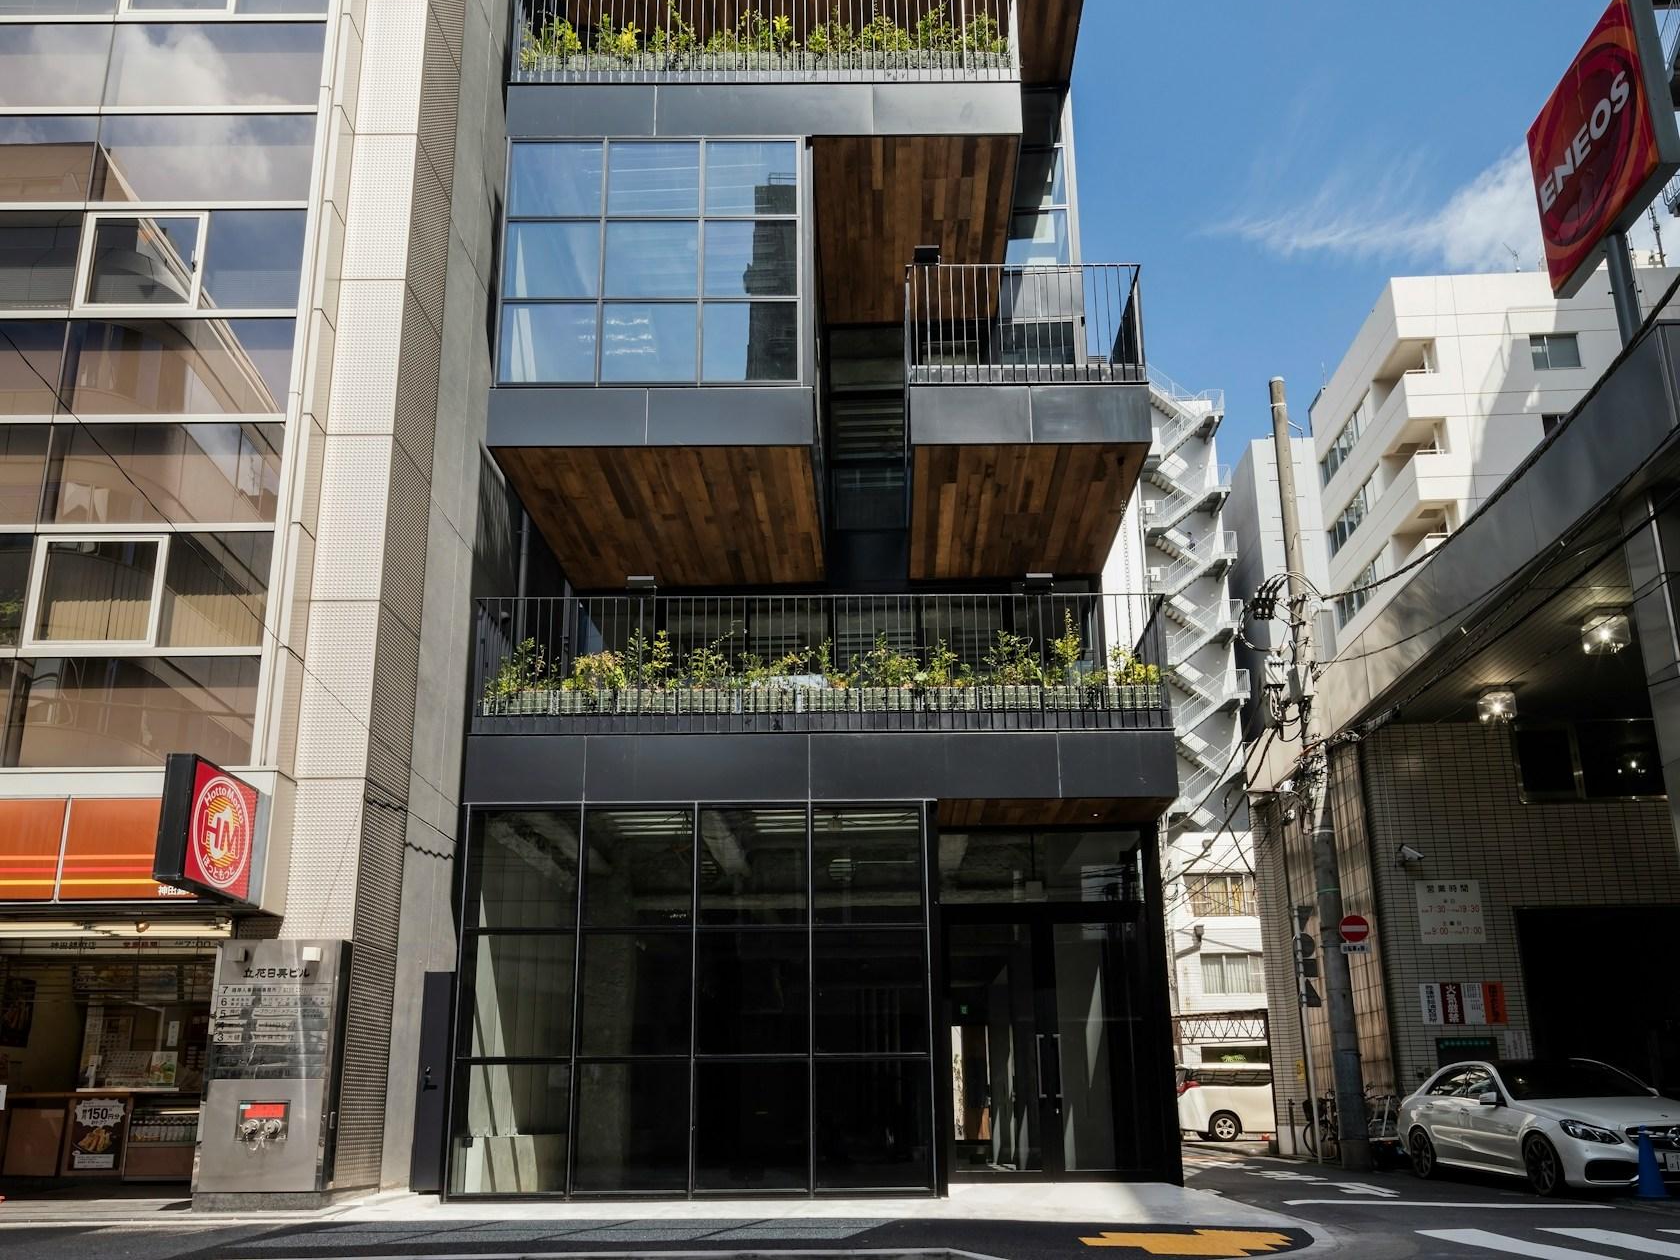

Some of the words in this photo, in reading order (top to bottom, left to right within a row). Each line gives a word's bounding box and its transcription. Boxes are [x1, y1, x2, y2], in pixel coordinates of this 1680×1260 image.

[1539, 70, 1631, 215] ENEOS
[204, 786, 227, 807] Hotto
[203, 854, 236, 880] ほっともっと
[222, 986, 229, 994] 7
[221, 998, 228, 1007] 6
[1446, 983, 1460, 1023] 火気厳禁
